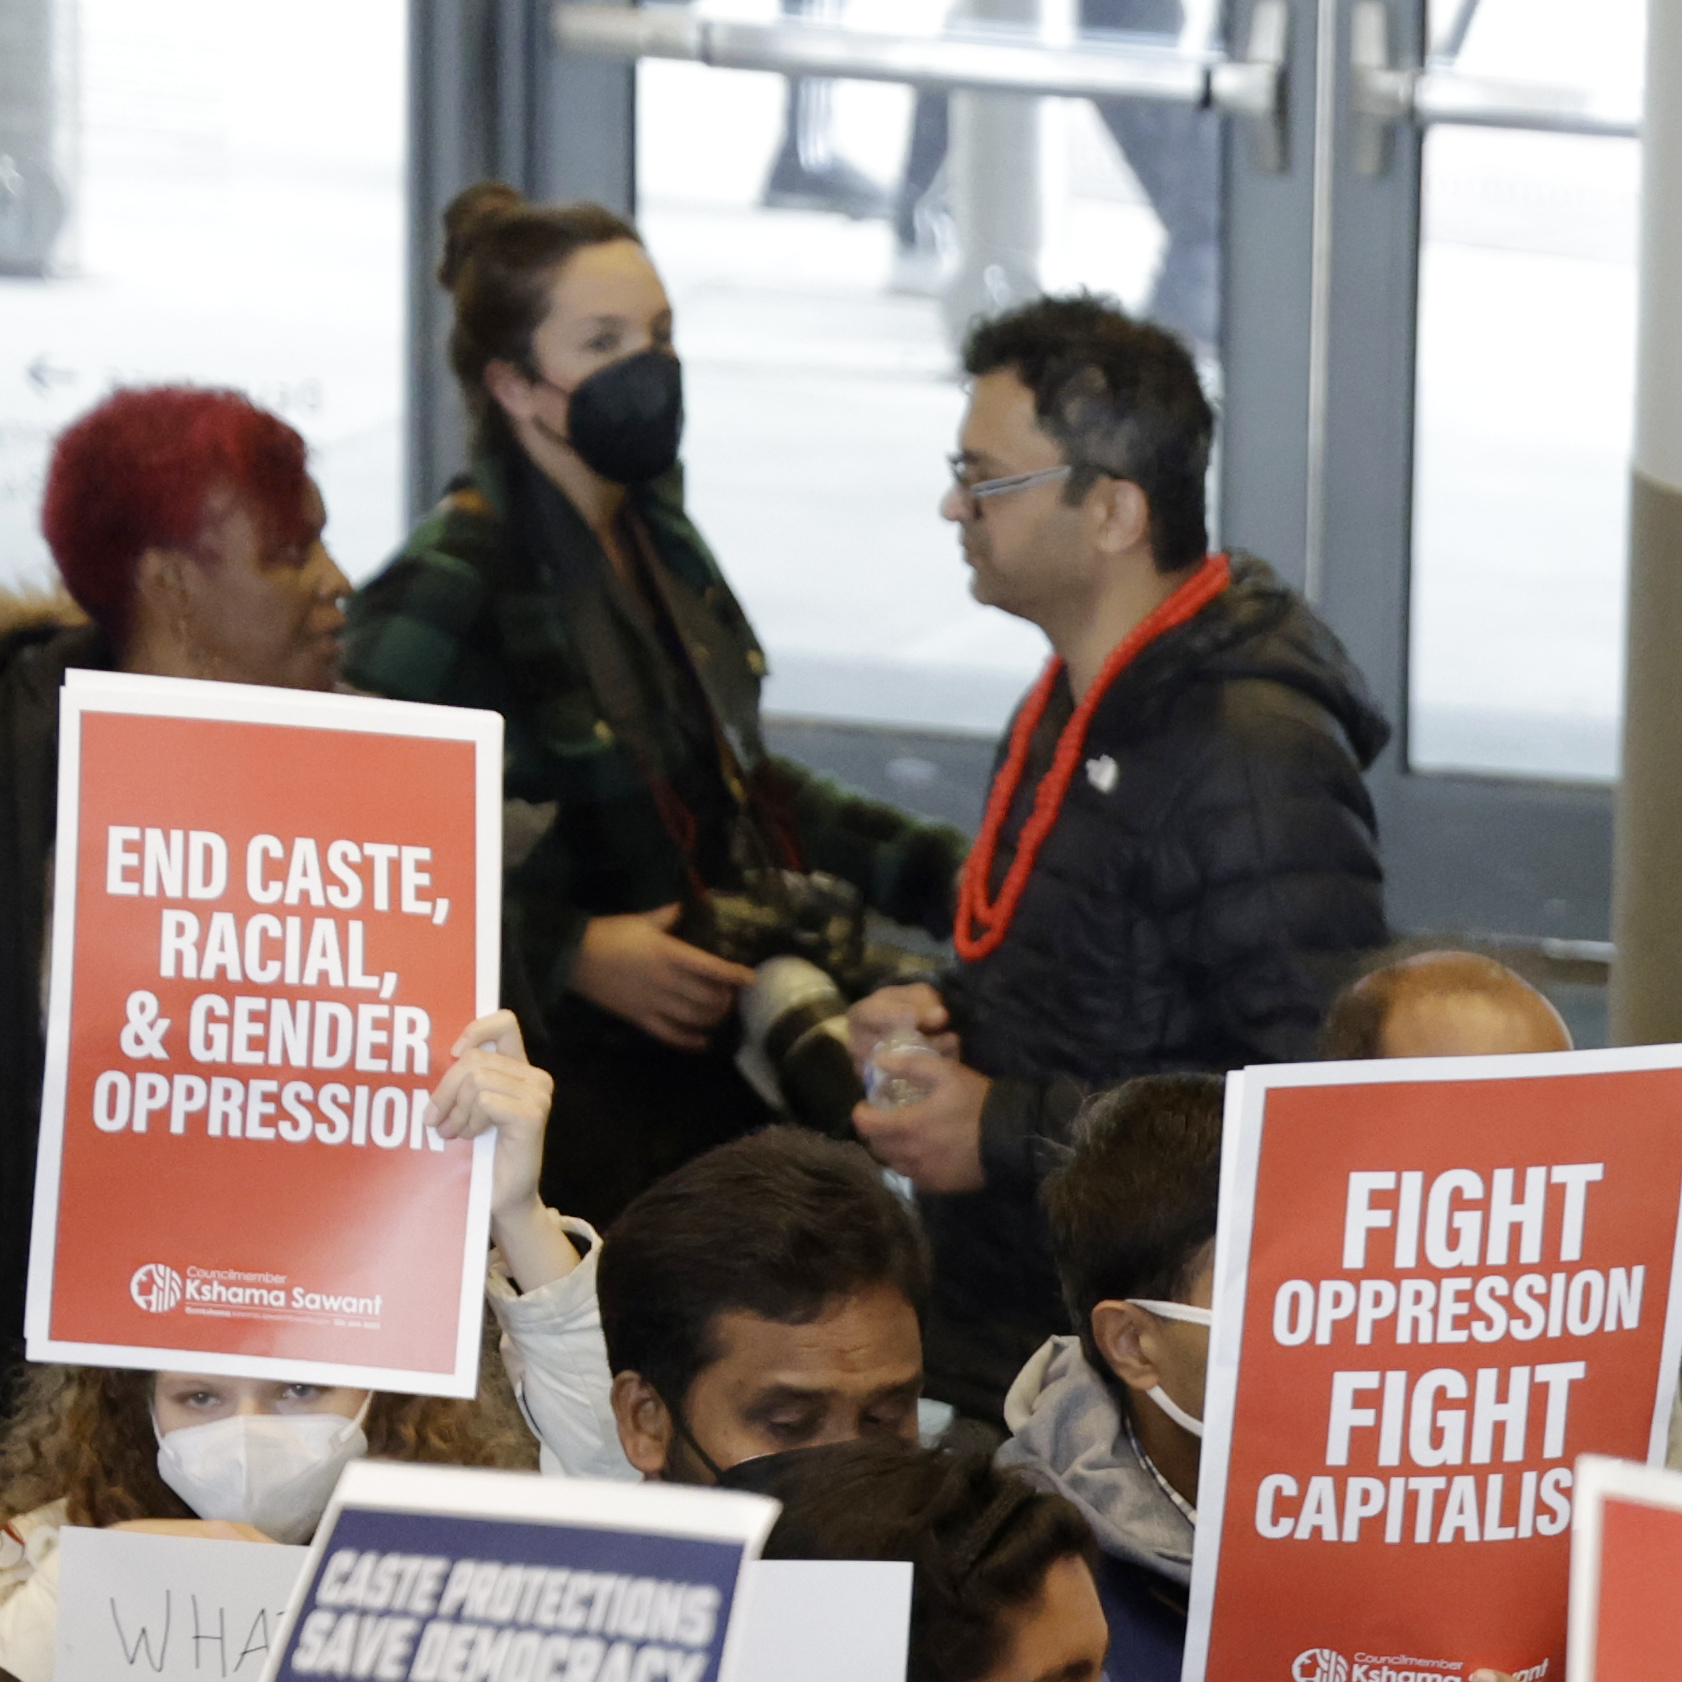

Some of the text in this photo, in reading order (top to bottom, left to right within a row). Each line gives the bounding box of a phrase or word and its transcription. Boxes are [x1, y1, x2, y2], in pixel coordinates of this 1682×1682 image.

[106, 826, 451, 925] END CASTE,
[159, 910, 397, 998] RACIAL,
[120, 990, 430, 1075] & GENDER
[1342, 1163, 1604, 1270] FIGHT
[185, 1279, 382, 1315] Kshama Sawant
[1272, 1265, 1645, 1346] OPPRESSION
[1325, 1360, 1586, 1468] FIGHT
[111, 1589, 284, 1677] WHA
[316, 1548, 720, 1647] CASTE PROTECTIONS
[292, 1607, 421, 1682] SAVE
[1354, 1652, 1464, 1670] Councilmember
